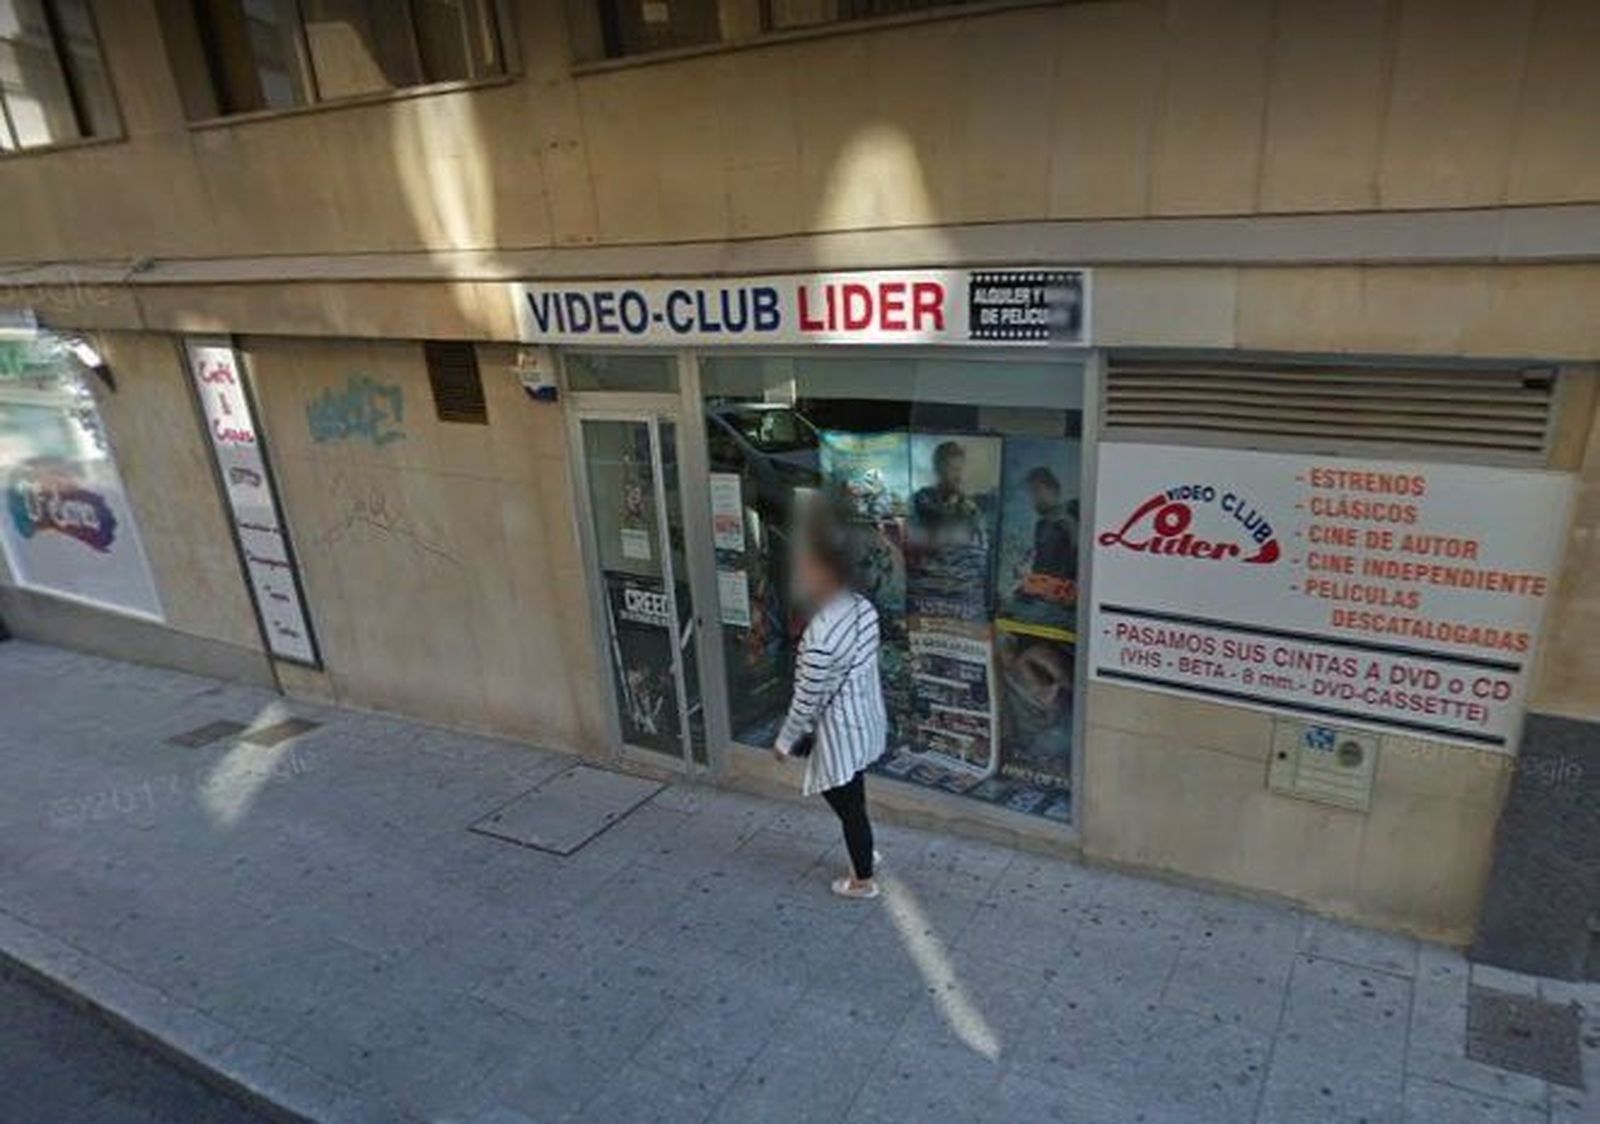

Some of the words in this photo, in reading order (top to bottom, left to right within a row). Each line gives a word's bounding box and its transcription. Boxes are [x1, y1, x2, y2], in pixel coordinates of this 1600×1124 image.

[526, 287, 782, 335] VIDEO-CLUB
[796, 281, 947, 331] LIDER
[980, 307, 999, 325] DE
[1310, 466, 1426, 497] ESTRENOS
[1166, 484, 1216, 502] VIDEO
[1221, 493, 1274, 545] CLUB
[1310, 494, 1418, 525] CLÁSICOS
[1308, 524, 1359, 548] CINE
[1366, 529, 1393, 551] DE
[1401, 534, 1479, 561] AUTOR
[1307, 551, 1355, 575] CINE
[1362, 558, 1547, 597] INDEPENDIENTE
[1332, 608, 1530, 653] DESCATALOGADAS
[1116, 623, 1216, 656] PASAMOS
[1222, 639, 1267, 664] SUS
[1272, 647, 1358, 679] CINTAS
[1364, 662, 1381, 681] A
[1390, 664, 1441, 691] DVD
[1472, 677, 1512, 702] CD
[1120, 648, 1162, 669] (VHS
[1178, 656, 1225, 679] BETA
[1242, 668, 1254, 685] 8
[1312, 678, 1490, 724] DVD-CASSETTE)
